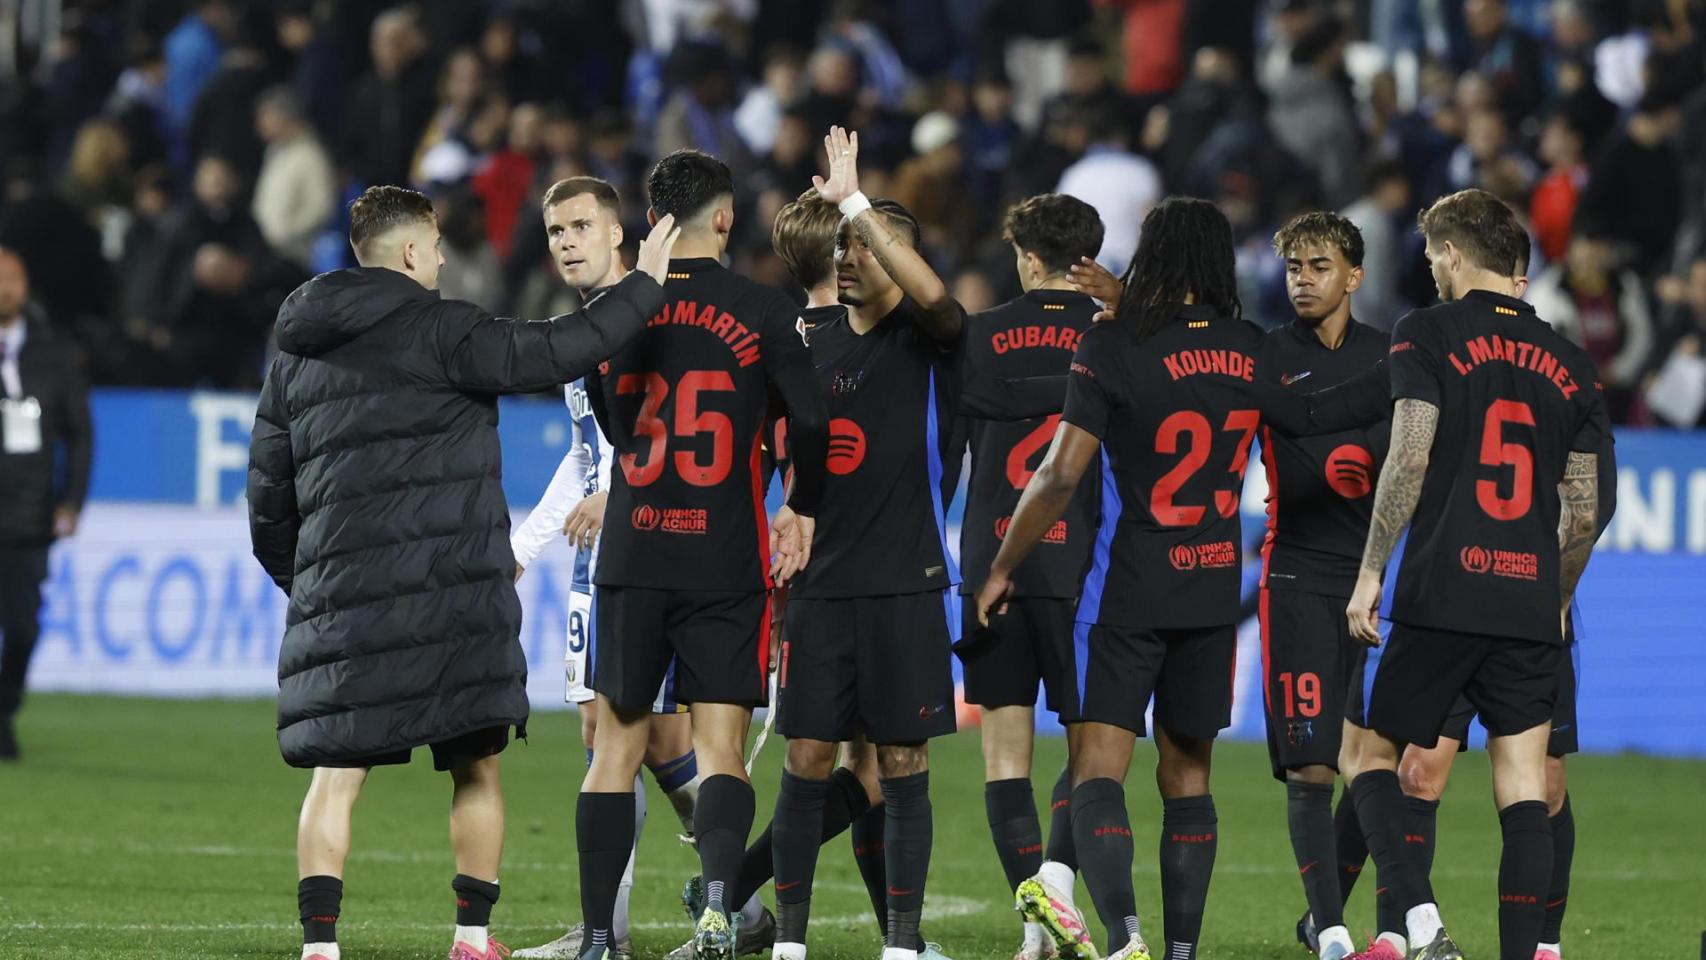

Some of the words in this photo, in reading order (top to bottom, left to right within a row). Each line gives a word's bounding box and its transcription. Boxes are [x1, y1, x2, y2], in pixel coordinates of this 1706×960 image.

[673, 300, 760, 368] MARTÍN
[1163, 350, 1254, 382] KOUNDE
[616, 370, 736, 487] 35
[1151, 410, 1260, 527] 23
[1476, 399, 1536, 521] 5
[662, 519, 706, 529] ACNUR
[663, 509, 707, 519] UNHCR
[1196, 541, 1234, 554] UNHCR
[1200, 552, 1235, 564] ACNUR
[1494, 550, 1537, 565] UNHCR
[1494, 561, 1537, 575] ACNUR
[569, 611, 585, 653] 9
[1279, 672, 1321, 717] 19
